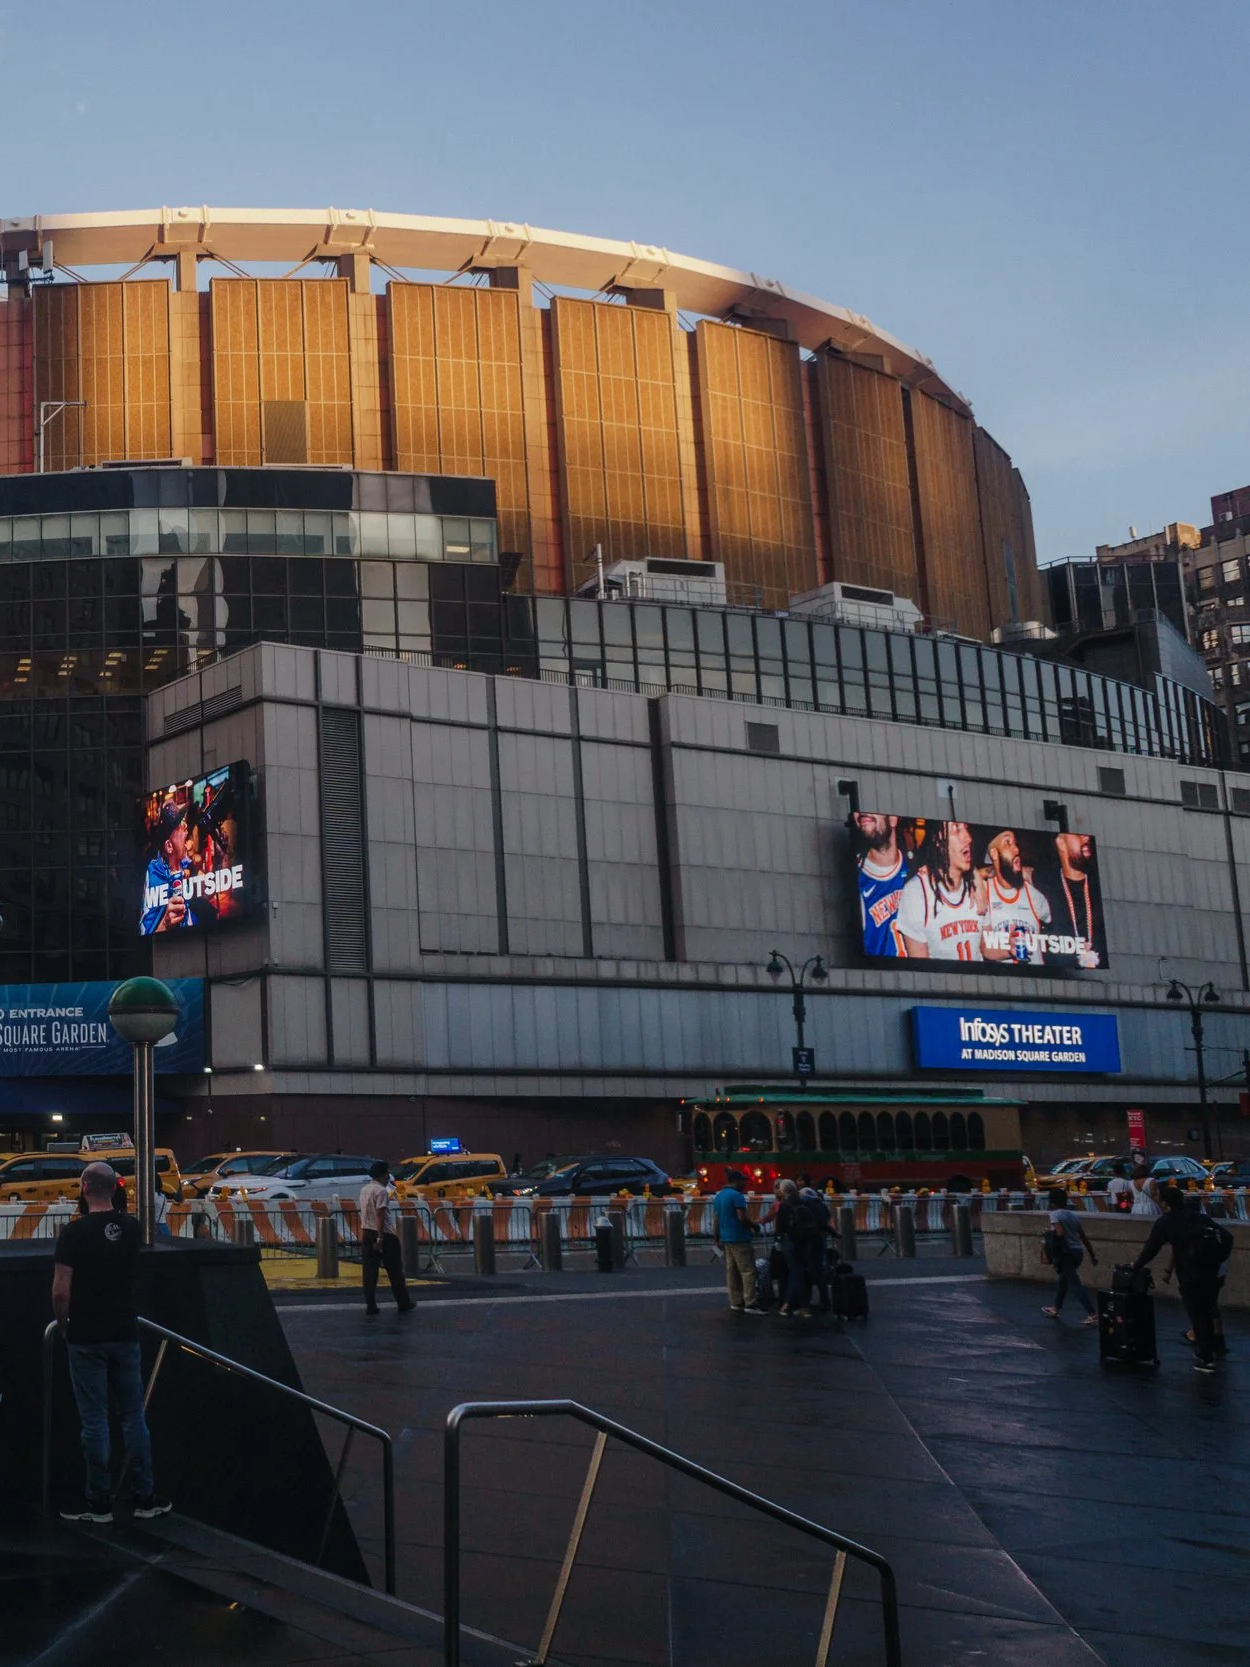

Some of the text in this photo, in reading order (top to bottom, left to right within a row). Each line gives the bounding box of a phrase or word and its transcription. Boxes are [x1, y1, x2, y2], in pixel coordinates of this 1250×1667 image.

[145, 884, 169, 909] WE
[983, 930, 1011, 950] WE
[9, 1007, 84, 1019] ENTRANCE
[52, 1021, 107, 1045] GARDEN
[959, 1017, 1083, 1047] Infosys THEATER
[961, 1048, 1086, 1063] AT MADISON SQUARE GARDEN
